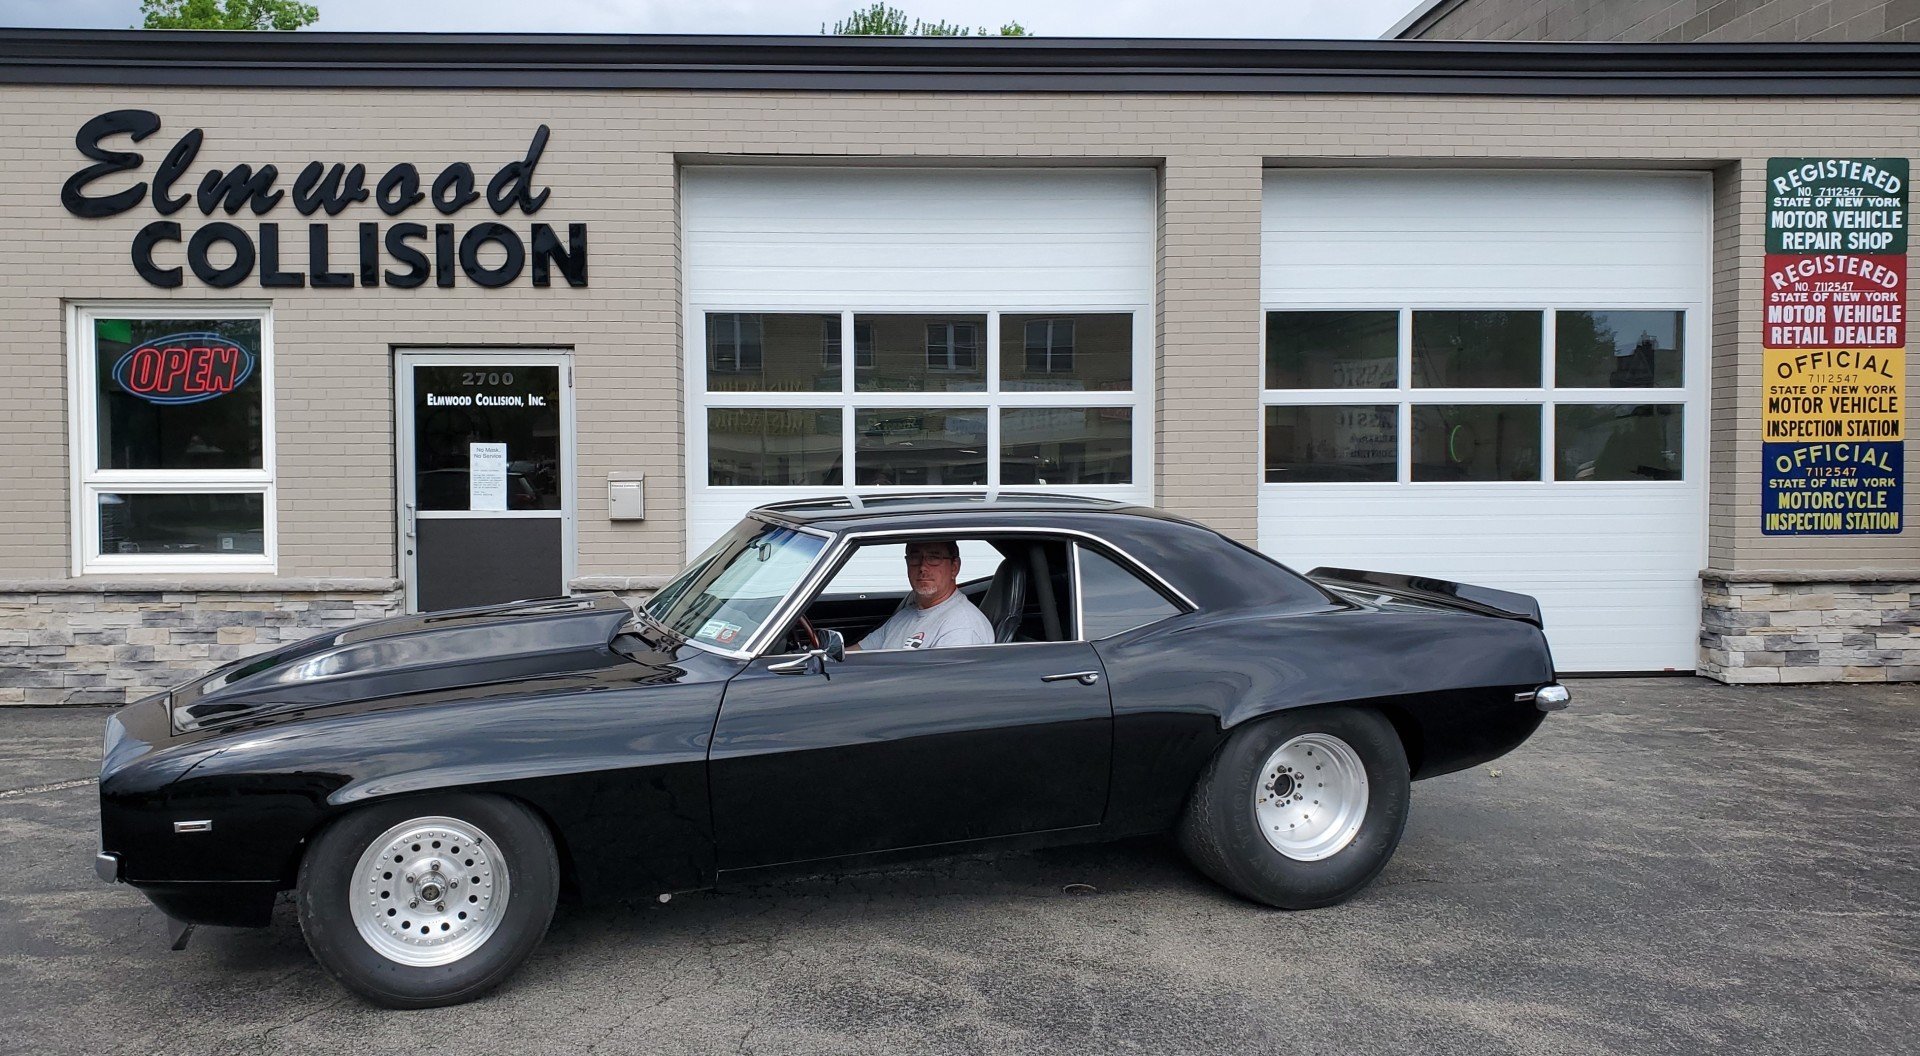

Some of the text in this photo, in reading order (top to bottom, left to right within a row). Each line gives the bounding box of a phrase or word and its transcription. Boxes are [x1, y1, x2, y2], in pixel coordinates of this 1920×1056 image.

[60, 109, 551, 219] Elmwood
[1773, 160, 1901, 195] REGISTERED
[1798, 187, 1863, 197] NO. 7112547
[1773, 197, 1901, 207] STATE OF NEW YORK
[1771, 211, 1903, 229] MOTOR VEHICLE
[1782, 232, 1893, 250] REPAIR SHOP
[131, 220, 589, 289] COLLISION
[1770, 255, 1899, 290] REGISTERED
[1795, 282, 1854, 292] NO. 7112547
[1771, 292, 1898, 302] STATE OF NEW YORK
[1768, 305, 1901, 324] MOTOR VEHICLE
[1771, 326, 1897, 345] RETAIL DEALER
[129, 347, 239, 392] OPEN
[1777, 351, 1893, 379] OFFICIAL
[462, 372, 514, 386] 2700
[1808, 374, 1858, 383] 7112547
[1770, 385, 1896, 395] STATE OF NEW YORK
[1768, 396, 1898, 414] MOTOR VEHICLE
[1767, 419, 1899, 437] INSPECTION STATION
[1776, 443, 1893, 473] OFFICIAL
[1806, 468, 1857, 477] 7112547
[1769, 478, 1896, 488] STATE OF NEW YORK
[1778, 491, 1887, 509] MOTORCYCLE
[1766, 512, 1899, 531] INSPECTION STATION
